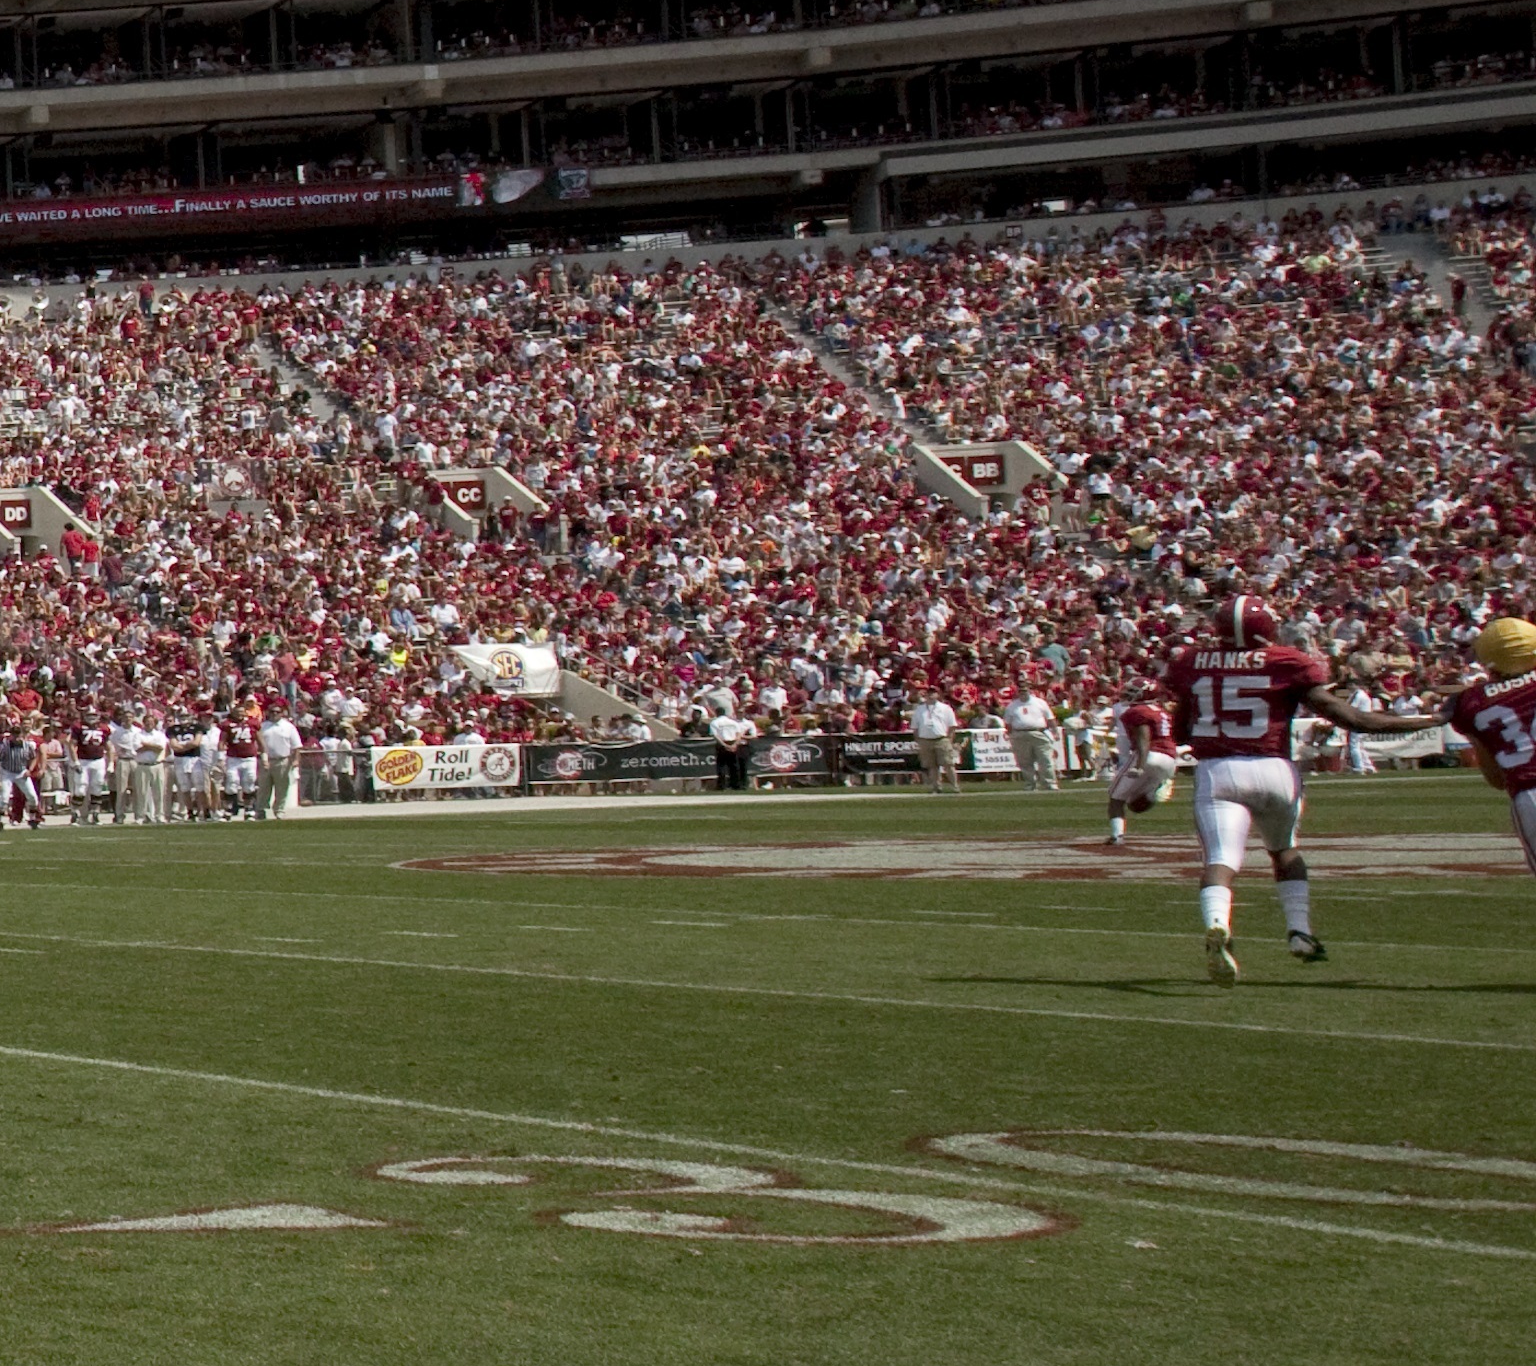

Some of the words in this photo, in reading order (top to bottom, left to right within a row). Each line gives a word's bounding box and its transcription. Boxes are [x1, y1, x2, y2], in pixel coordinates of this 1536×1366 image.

[16, 209, 67, 222] WAITED
[71, 209, 81, 220] A
[84, 207, 122, 218] LONG
[236, 199, 246, 210] A
[249, 196, 295, 208] SAUCE
[298, 192, 358, 205] WORTHY
[363, 190, 380, 202] OF
[385, 188, 407, 200] ITS
[411, 185, 452, 198] NAME
[457, 487, 482, 503] CC
[4, 506, 27, 521] DD
[495, 651, 522, 679] SEC
[1194, 650, 1268, 671] HANKS
[1191, 674, 1272, 740] 15
[82, 729, 103, 745] 75
[231, 726, 251, 744] 74
[1472, 704, 1536, 769] 3
[379, 751, 418, 773] GOLDEN
[434, 749, 469, 765] Roll
[385, 761, 418, 783] FLAKE
[427, 766, 472, 782] Tide!
